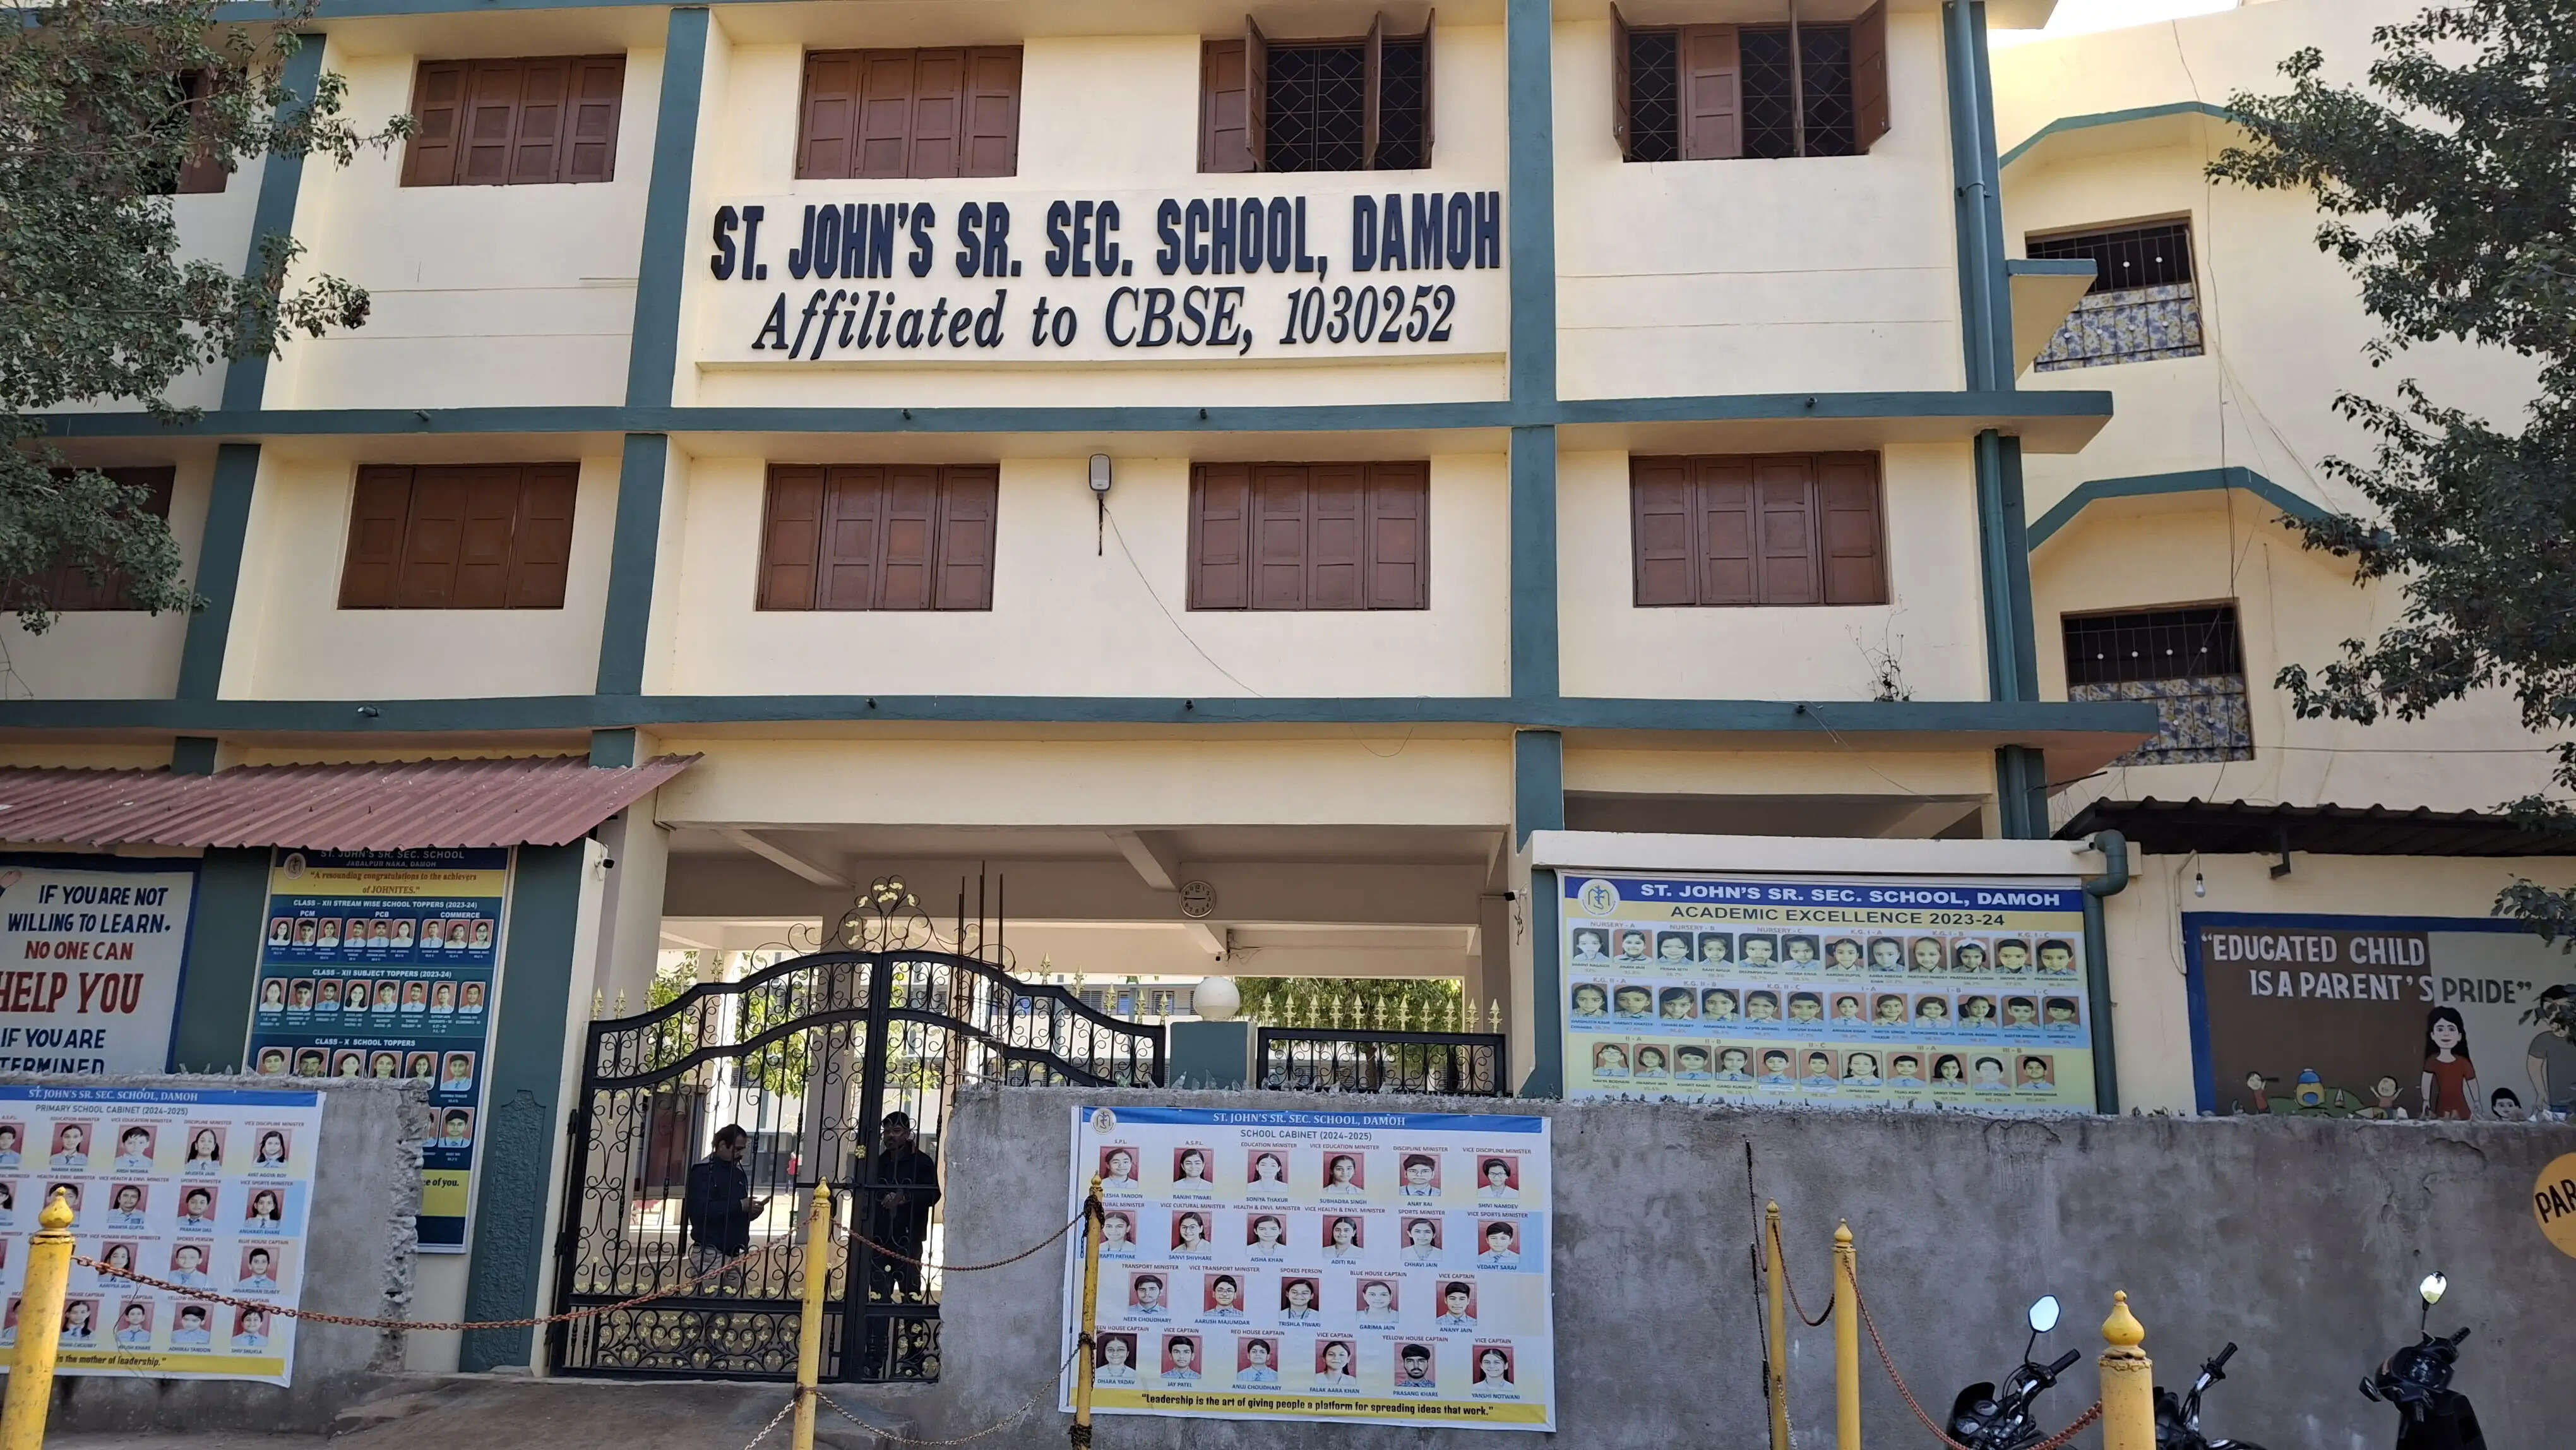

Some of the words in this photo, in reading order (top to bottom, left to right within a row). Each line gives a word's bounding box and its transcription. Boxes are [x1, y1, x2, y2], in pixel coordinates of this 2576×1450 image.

[711, 205, 766, 280] ST.
[789, 201, 935, 279] JOHN'S
[957, 201, 1020, 278] SR.
[1046, 200, 1132, 277] SEC.
[1157, 196, 1327, 282] SCHOOL,
[1352, 191, 1501, 273] DAMOH
[752, 288, 1007, 360] Affiliated
[1032, 296, 1077, 347] to
[1106, 285, 1255, 356] CBSE,
[1279, 284, 1457, 345] 1030252
[322, 872, 361, 881] resounding
[363, 872, 419, 882] congratulations
[39, 885, 57, 904] IF
[63, 886, 97, 904] YOU
[98, 887, 131, 904] ARE
[134, 887, 169, 906] NOT
[362, 885, 371, 894] of
[1641, 884, 1671, 896] ST.
[1679, 885, 1761, 899] JOHN'S
[1768, 887, 1804, 901] SR.
[1811, 889, 1862, 902] SEC.
[1869, 891, 1971, 906] SCHOOL,
[1977, 893, 2060, 906] DAMOH
[8, 913, 75, 932] WILLING
[79, 914, 96, 932] TO
[100, 914, 170, 933] LEARN.
[1671, 906, 1778, 920] ACADEMIC
[1786, 909, 1923, 924] EXCELLENCE
[1929, 913, 2005, 926] 2023-24
[24, 941, 50, 959] NO
[54, 942, 90, 959] ONE
[93, 942, 134, 960] CAN
[2350, 937, 2424, 966] CHILD
[0, 971, 68, 1012] HELP
[77, 973, 144, 1014] YOU
[2250, 969, 2273, 996] IS
[2277, 971, 2294, 997] A
[2300, 972, 2433, 1001] PARENT'S
[1, 1028, 21, 1047] IF
[26, 1028, 63, 1048] YOU
[63, 1029, 106, 1048] ARE
[28, 1089, 41, 1098] ST.
[44, 1089, 77, 1101] JOHN'S
[117, 1091, 158, 1101] SCHOOL,
[161, 1092, 198, 1101] DAMOH
[142, 1107, 188, 1116] (2024-2025)
[1213, 1113, 1228, 1122] ST.
[1231, 1113, 1267, 1123] JOHN'S
[1270, 1114, 1286, 1123] SR.
[1289, 1114, 1312, 1123] SEC.
[1314, 1115, 1360, 1126] SCHOOL,
[1364, 1117, 1405, 1126] DAMOH
[1240, 1129, 1276, 1137] SCHOOL
[1320, 1132, 1371, 1141] (2024-2025)
[442, 1180, 459, 1188] you.
[65, 1355, 76, 1363] the
[79, 1355, 105, 1364] mother
[1196, 1394, 1204, 1405] is
[1207, 1395, 1220, 1406] the
[1222, 1396, 1235, 1406] art
[1237, 1396, 1246, 1406] of
[1248, 1397, 1273, 1409] giving
[1276, 1399, 1305, 1410] people
[1315, 1400, 1352, 1411] platform
[1356, 1401, 1369, 1411] for
[1371, 1402, 1415, 1414] spreading
[1418, 1403, 1441, 1413] ideas
[1444, 1405, 1460, 1415] that
